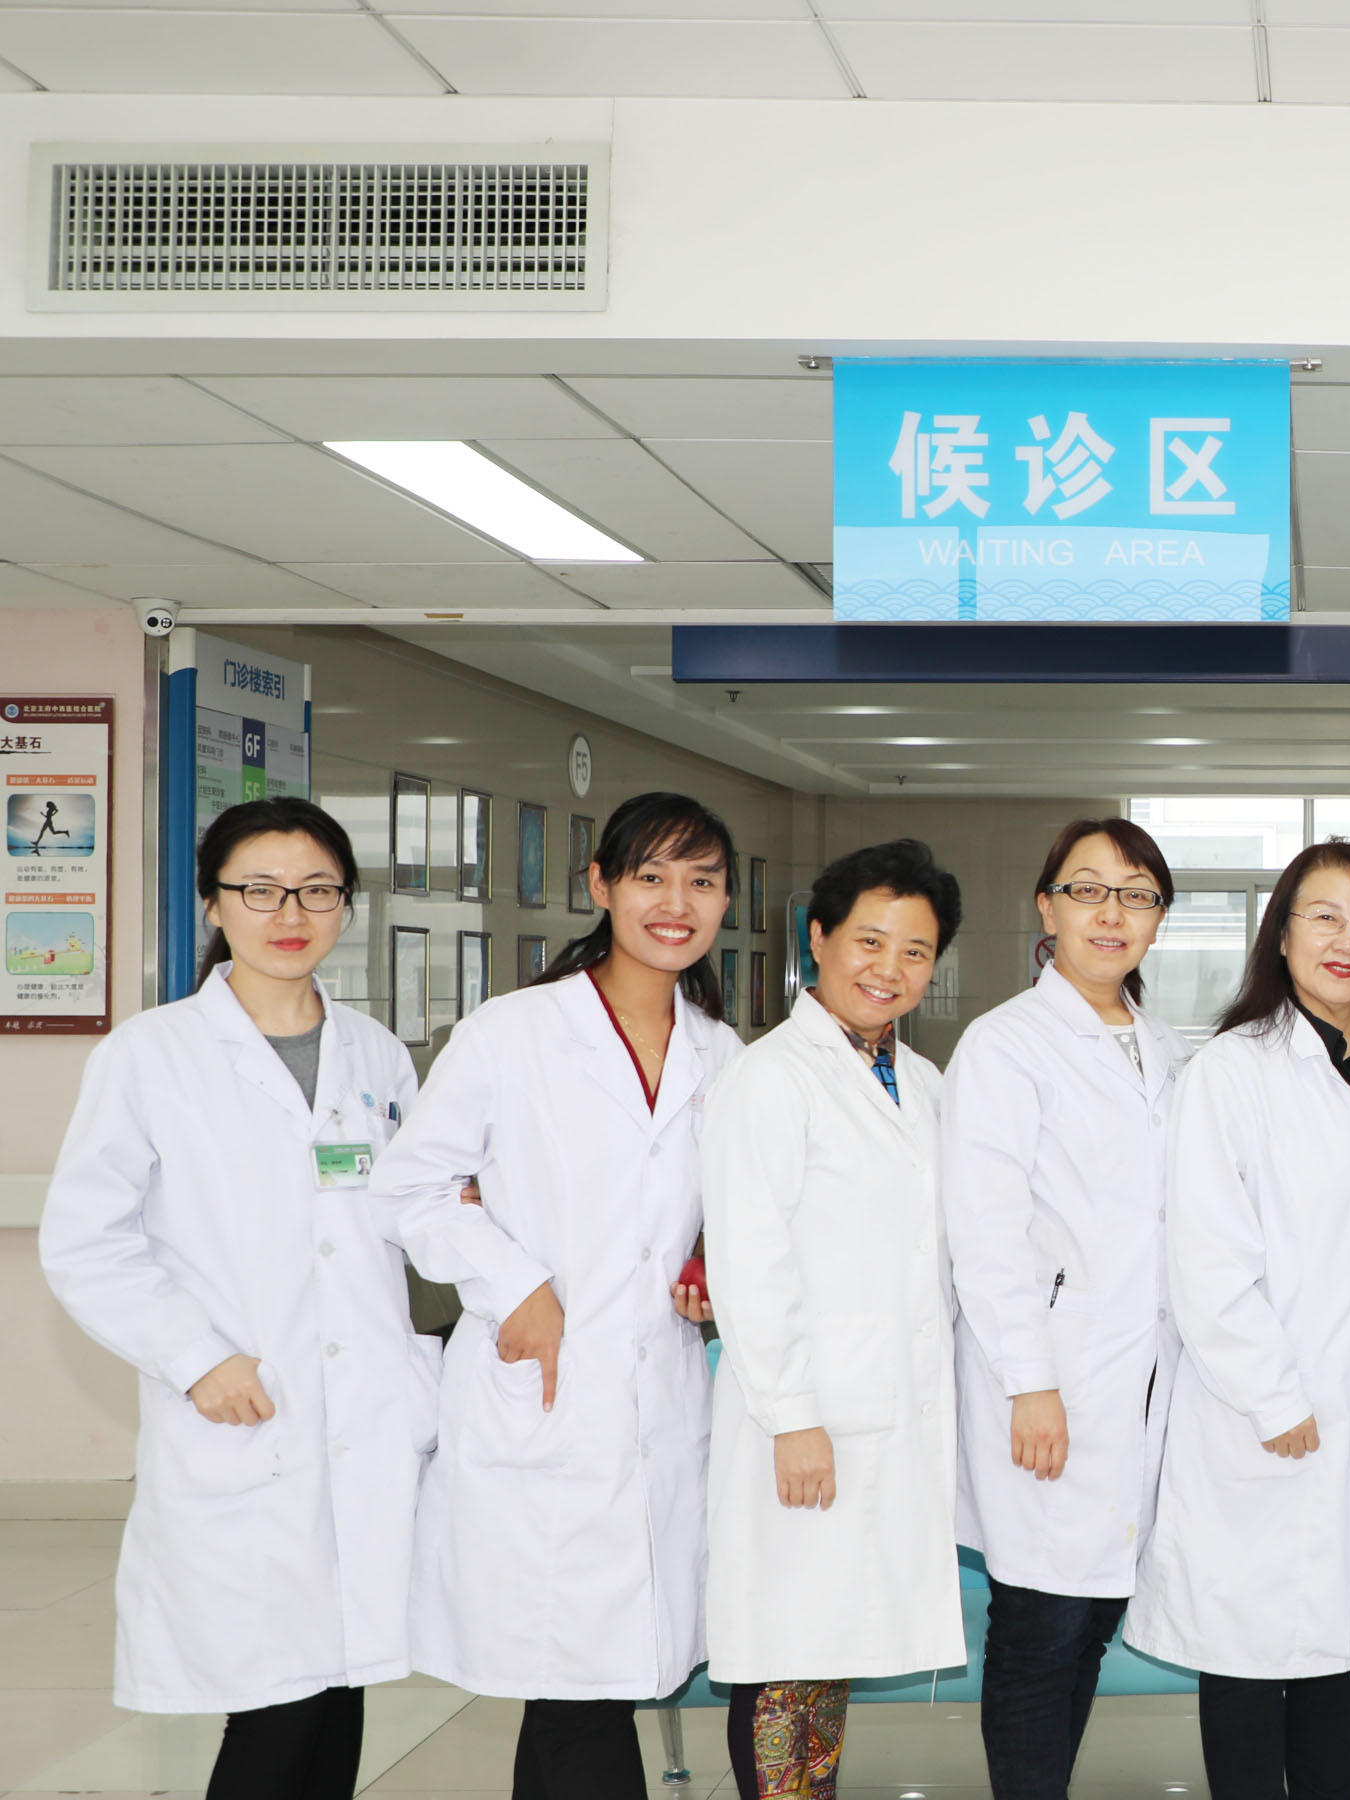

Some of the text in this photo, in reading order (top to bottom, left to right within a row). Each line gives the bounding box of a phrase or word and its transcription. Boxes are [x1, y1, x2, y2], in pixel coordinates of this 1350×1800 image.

[888, 410, 1236, 520] 候诊区
[918, 539, 1206, 567] WAITING AREA
[223, 658, 285, 701] 门诊楼索引
[0, 735, 42, 749] 大基石
[244, 733, 261, 758] 6F
[575, 751, 589, 783] F5
